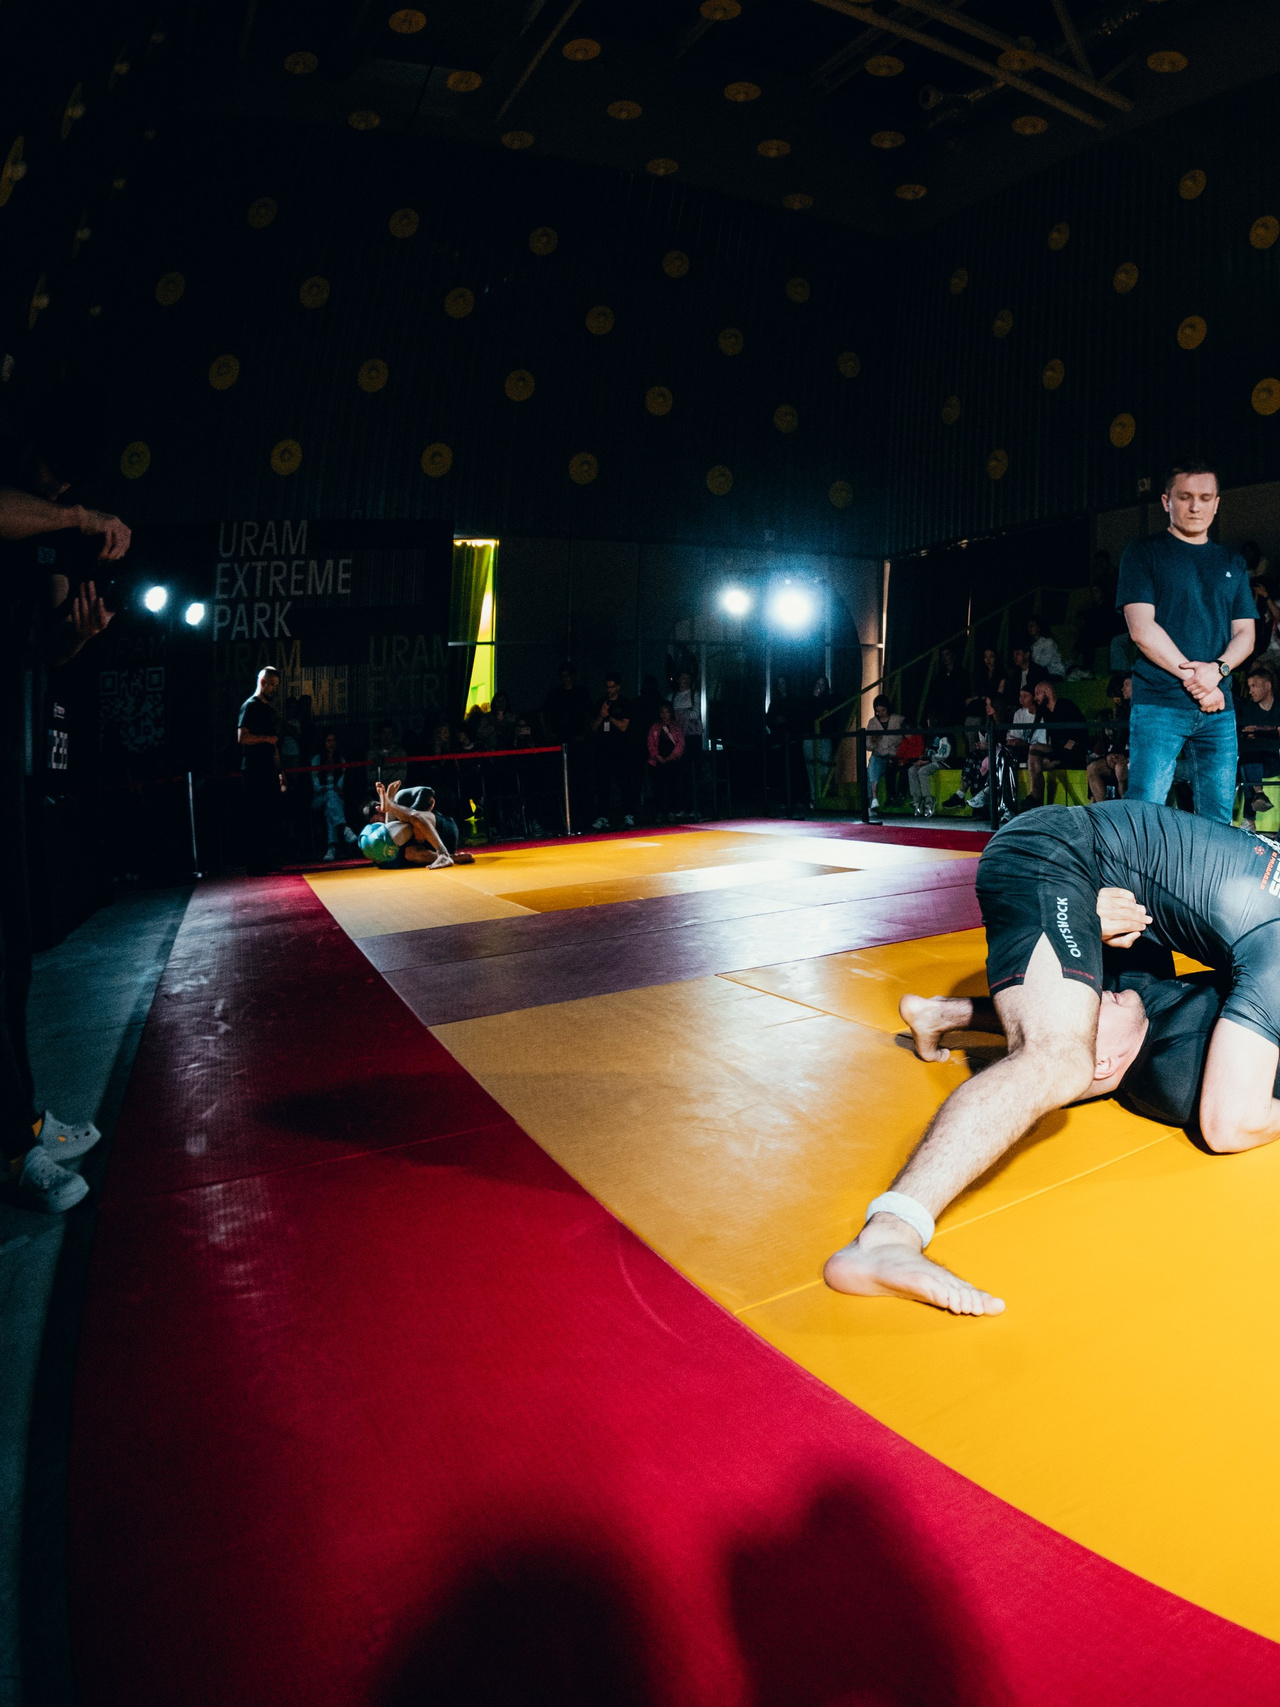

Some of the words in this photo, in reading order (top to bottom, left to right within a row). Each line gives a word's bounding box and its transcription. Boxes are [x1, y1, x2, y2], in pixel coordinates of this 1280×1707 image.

[217, 519, 309, 558] URAM
[213, 557, 354, 600] EXTREME
[211, 600, 293, 642] PARK
[1056, 896, 1082, 958] OUTSHOCK
